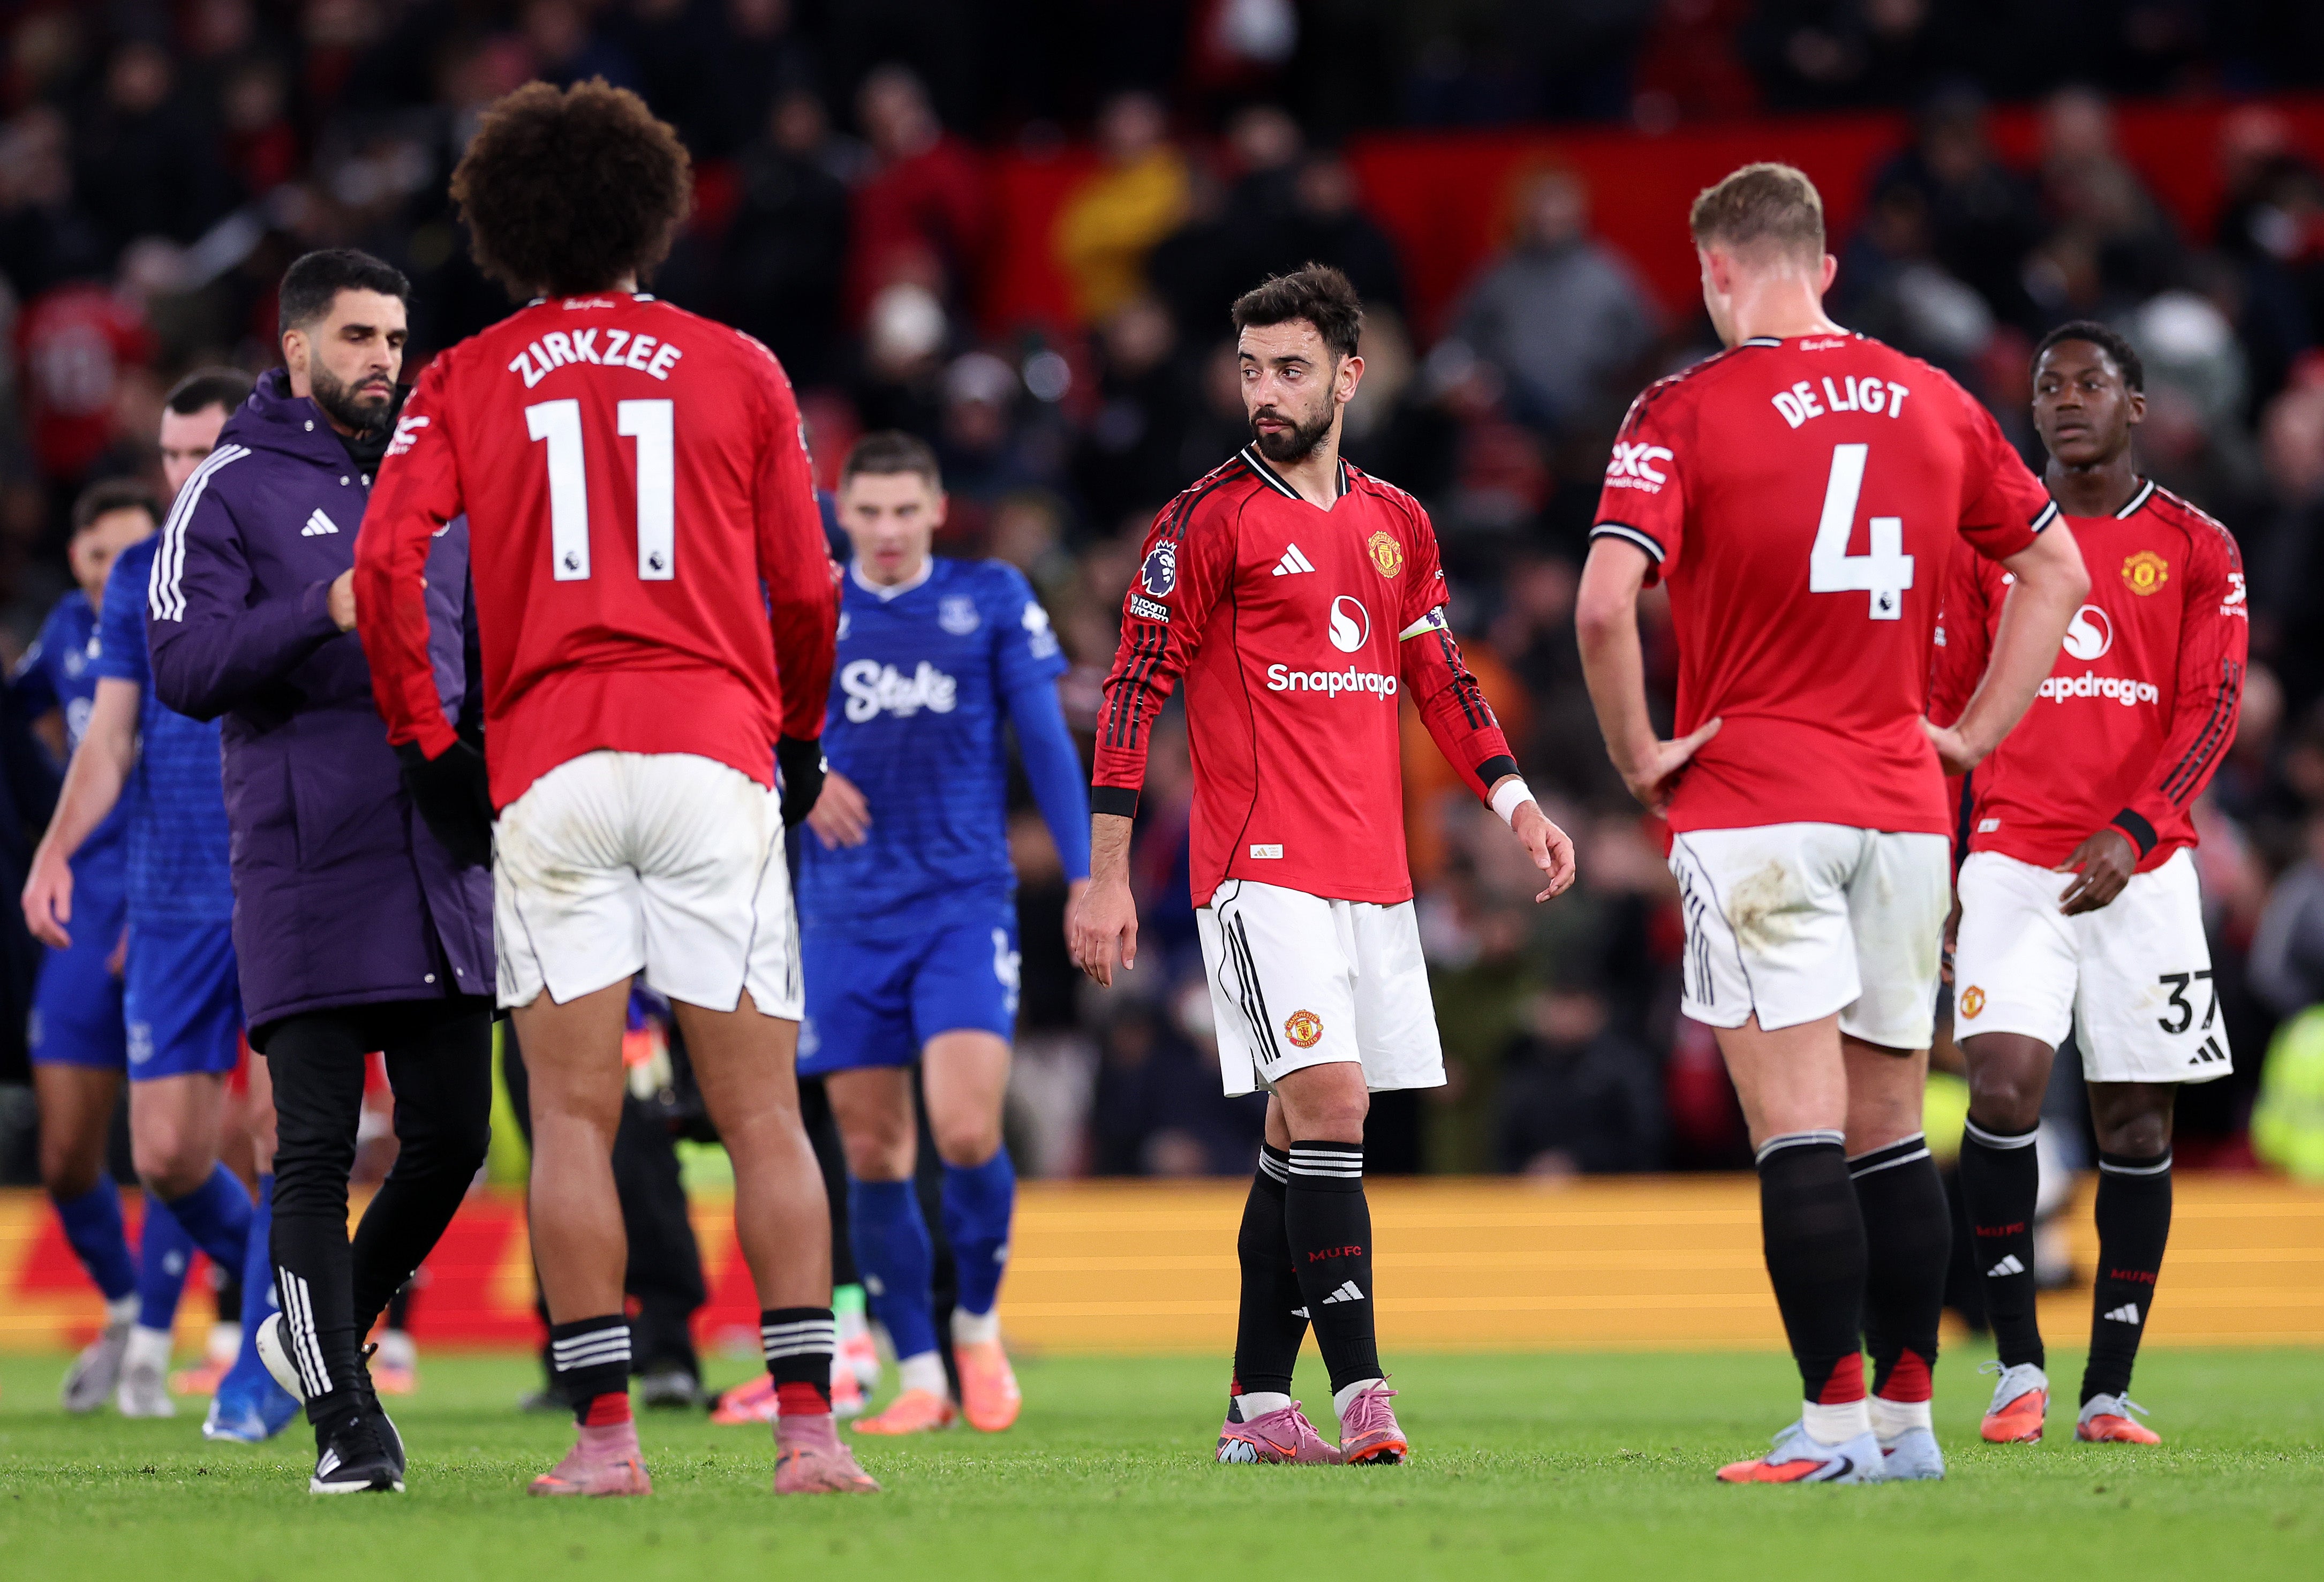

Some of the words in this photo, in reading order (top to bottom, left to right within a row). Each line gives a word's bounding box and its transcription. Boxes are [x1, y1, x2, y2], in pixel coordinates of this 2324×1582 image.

[508, 327, 683, 389] ZIRKZEE
[1771, 380, 1825, 430] DE
[1821, 374, 1910, 419] LIGT
[524, 398, 674, 582] 11
[1370, 534, 1399, 552] MANCHESTER
[1809, 442, 1915, 620] 4
[1378, 565, 1398, 575] UNITED
[1134, 606, 1169, 623] racism
[1138, 598, 1166, 615] room
[840, 659, 957, 724] Stake
[1267, 664, 1397, 702] Snapdrago
[2159, 970, 2216, 1035] 37
[1287, 1013, 1317, 1028] MANCHESTER
[1296, 1037, 1317, 1046] UNITED
[1308, 1246, 1362, 1263] MUFC
